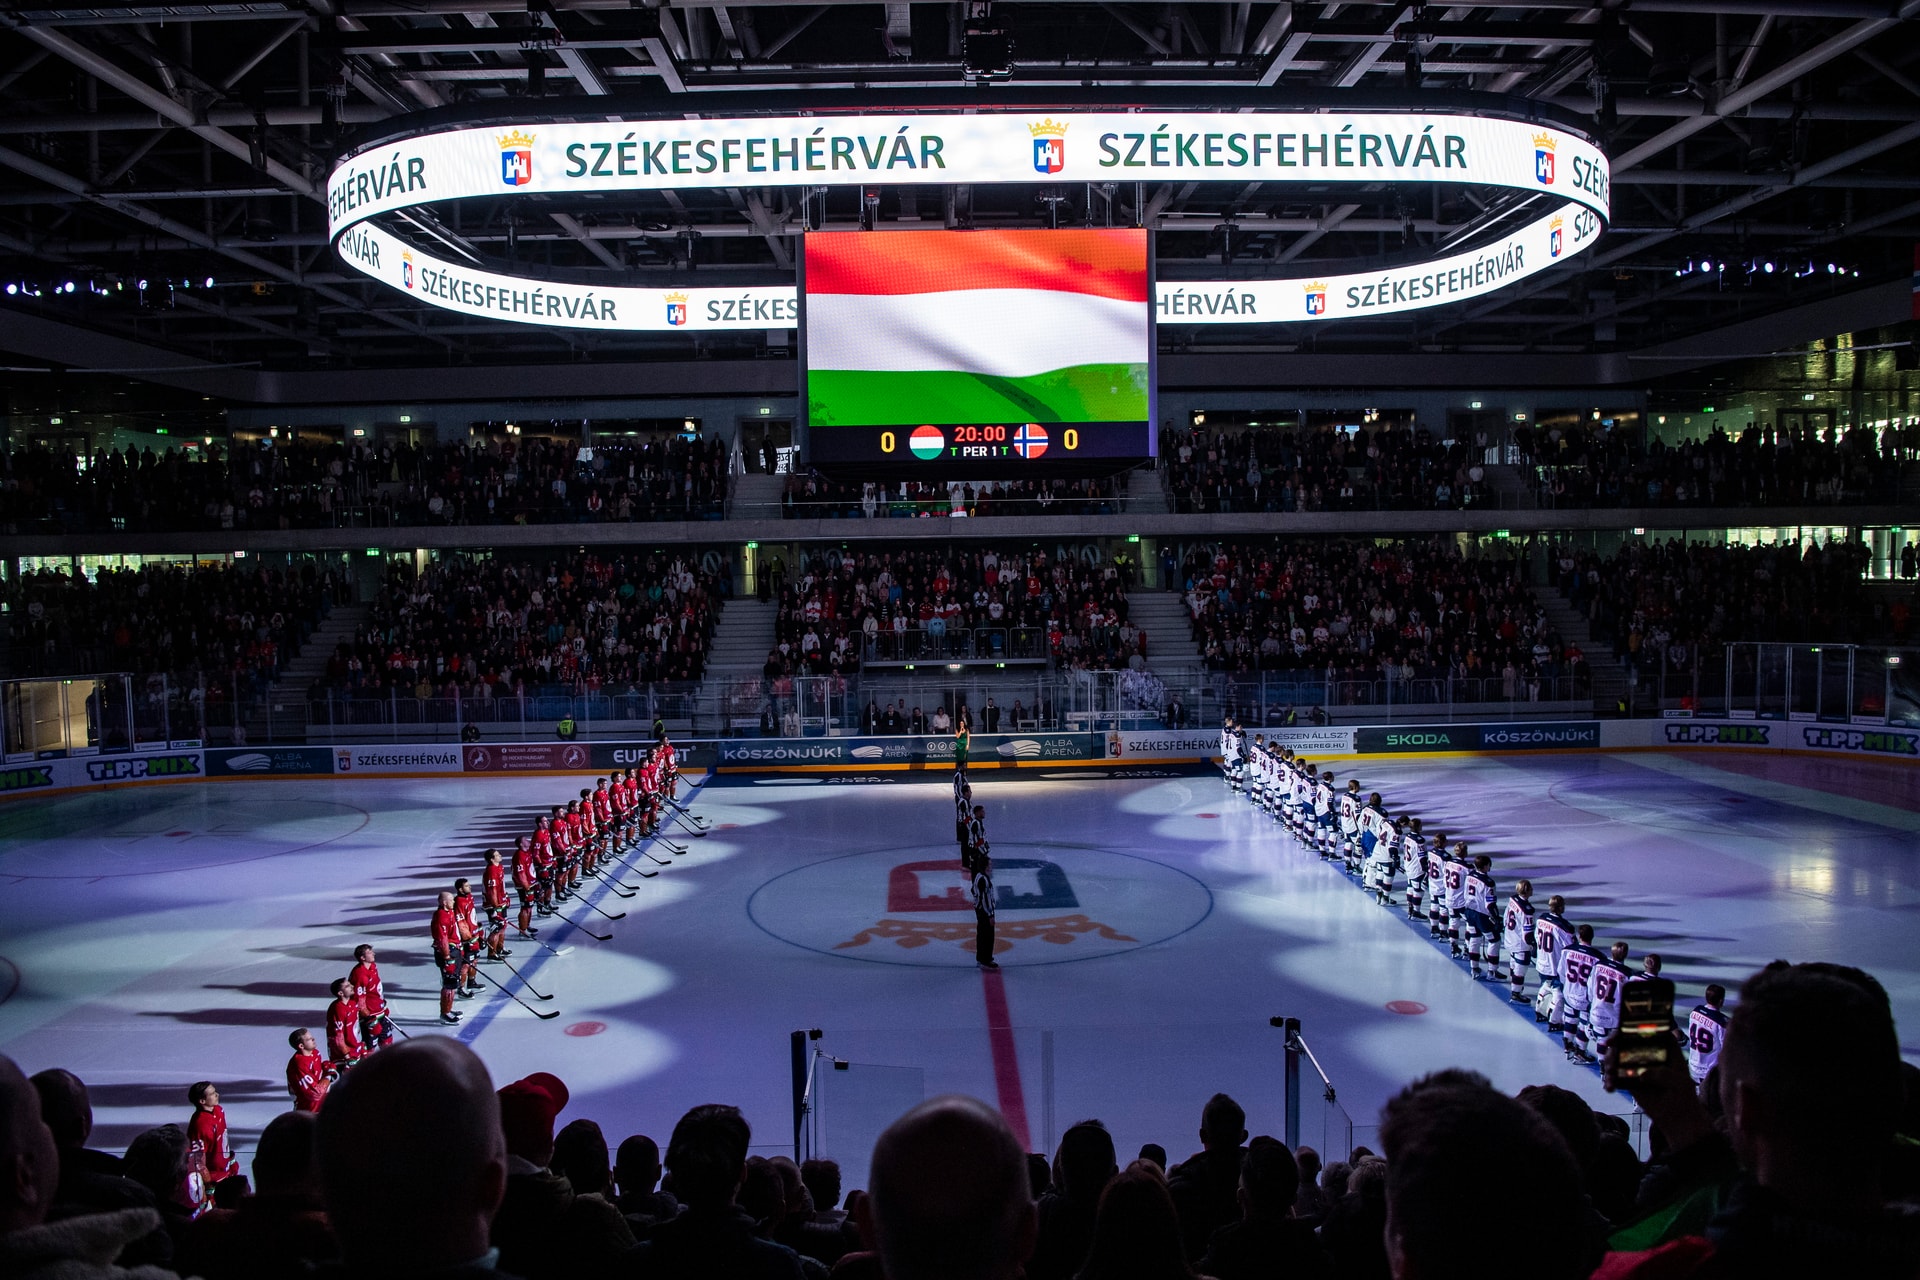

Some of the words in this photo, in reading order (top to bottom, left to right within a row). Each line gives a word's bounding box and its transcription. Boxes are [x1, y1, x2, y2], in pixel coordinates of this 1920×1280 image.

[566, 126, 945, 177] SZÉKESFEHÉRVÁR
[1099, 124, 1467, 168] SZÉKESFEHÉRVÁR
[1345, 244, 1525, 310] SZÉKESFEHÉRVÁR
[421, 267, 617, 322] SZÉKESFEHÉRVÁR
[707, 293, 798, 322] SZÉKES
[880, 431, 895, 453] 0
[954, 426, 1006, 442] 20:00
[1063, 429, 1078, 450] 0
[963, 446, 988, 457] PER
[992, 447, 997, 457] 1
[1044, 739, 1074, 747] ALBA
[1129, 738, 1221, 752] SZÉKESFEHÉRVÁ
[1484, 728, 1595, 744] KÖSZÖNJÜK!
[274, 753, 302, 761] ALBA
[357, 752, 458, 766] SZÉKESFEHÉRVÁR
[724, 746, 842, 760] KÖSZÖNJÜK!
[1596, 974, 1618, 1004] 61
